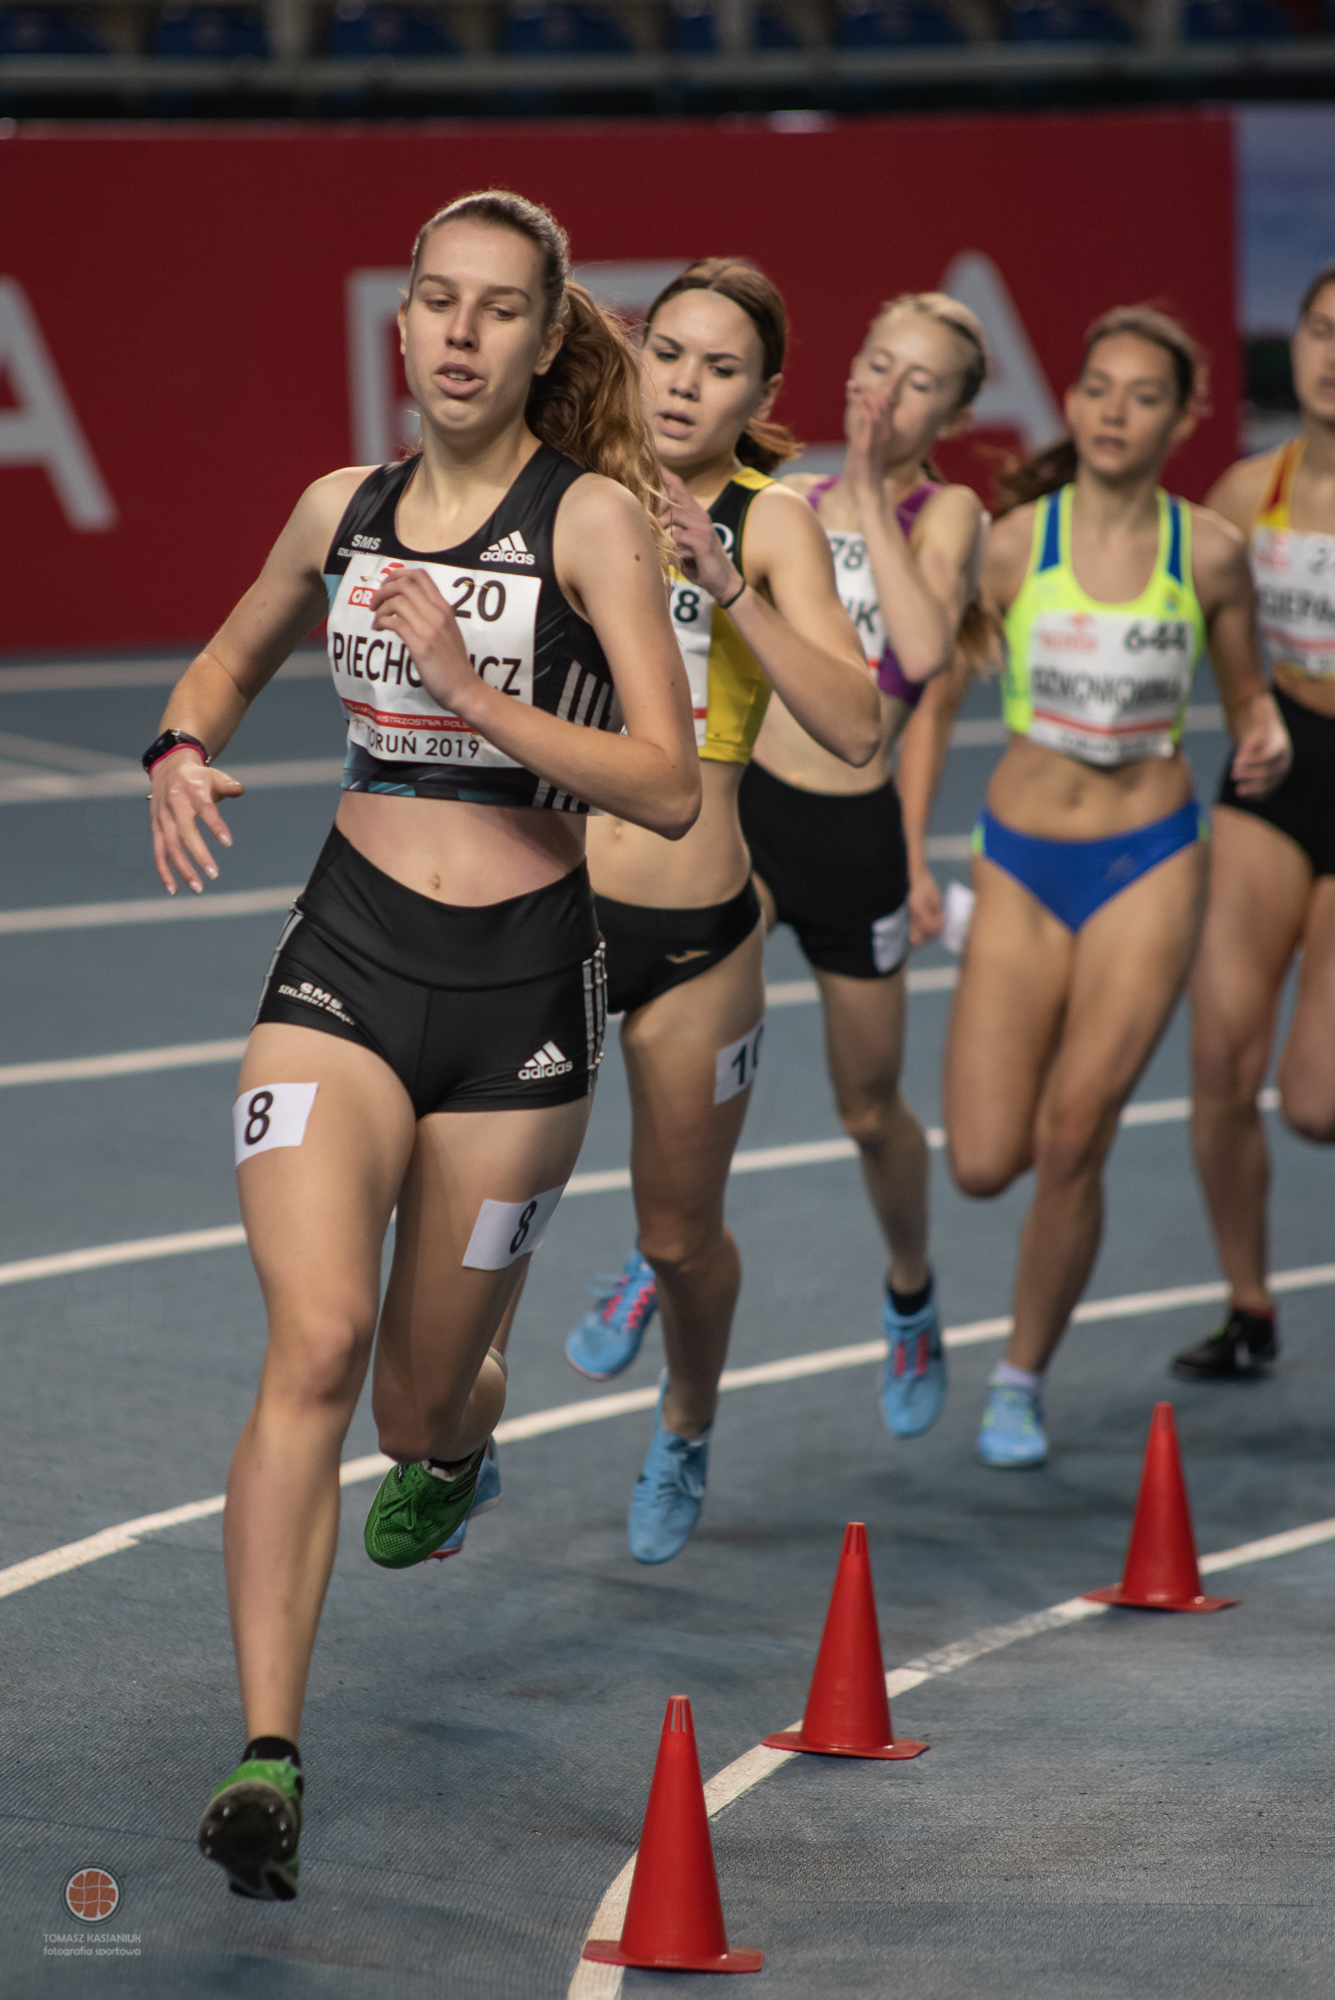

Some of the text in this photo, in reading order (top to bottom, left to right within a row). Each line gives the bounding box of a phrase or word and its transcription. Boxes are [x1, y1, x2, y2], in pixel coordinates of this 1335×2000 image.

[351, 533, 382, 551] SMS
[479, 548, 535, 566] adidas
[351, 588, 374, 606] OR
[452, 575, 506, 623] 20
[367, 725, 480, 759] TORUŃ 2019
[300, 982, 343, 1010] SMS
[517, 1059, 573, 1081] adidas
[244, 1090, 274, 1147] 8
[509, 1200, 538, 1255] 8
